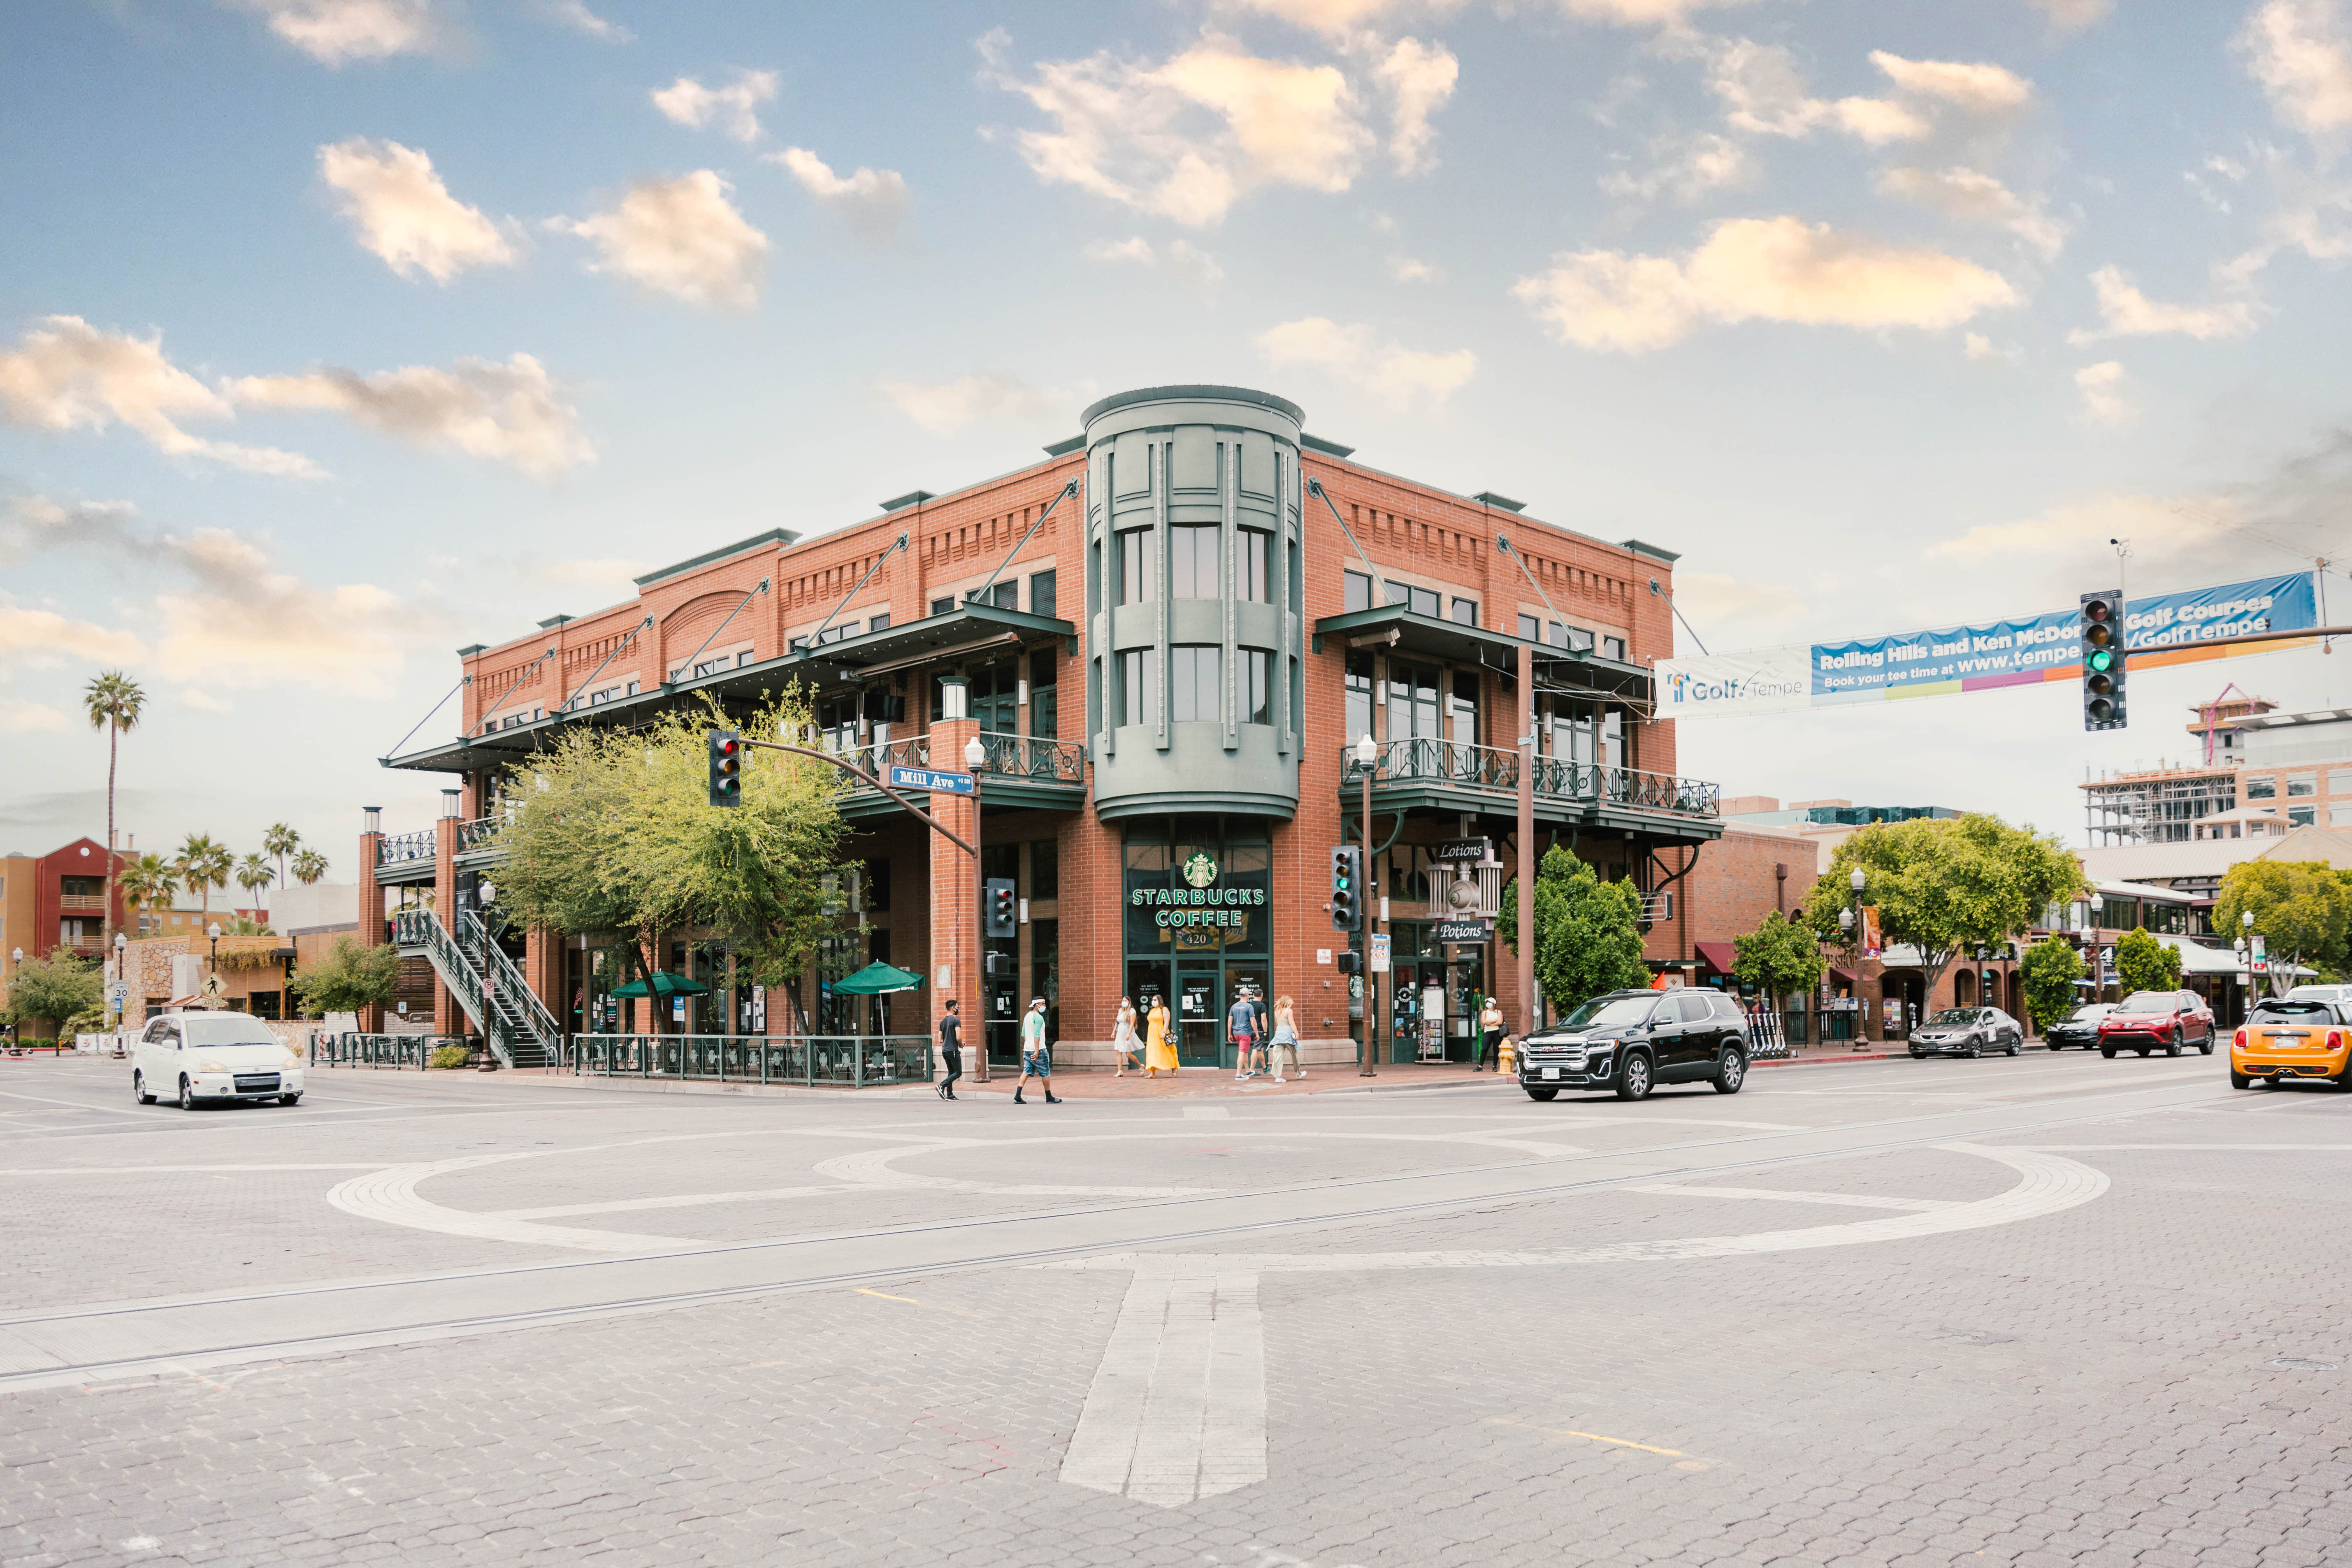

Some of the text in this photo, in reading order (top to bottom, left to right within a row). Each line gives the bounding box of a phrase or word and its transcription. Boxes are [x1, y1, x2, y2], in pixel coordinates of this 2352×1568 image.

[1820, 651, 1884, 670] Rolling
[1887, 644, 1928, 662] Hills
[1931, 637, 1969, 657] and
[1973, 635, 2013, 652] Ken
[2125, 607, 2173, 630] Golf
[2177, 595, 2273, 622] Courses
[1824, 675, 1855, 688] Book
[1858, 673, 1885, 686] your
[1888, 671, 1907, 681] tee
[1910, 667, 1938, 678] time
[1941, 664, 1954, 675] at
[1751, 681, 1802, 697] Tempe
[899, 771, 927, 785] Mill
[931, 775, 954, 788] Ave
[1440, 843, 1482, 857] Lotions
[1133, 888, 1264, 905] STARBUCKS
[1156, 910, 1242, 927] COFFEE
[1186, 934, 1206, 944] 420
[1440, 924, 1482, 939] Potions
